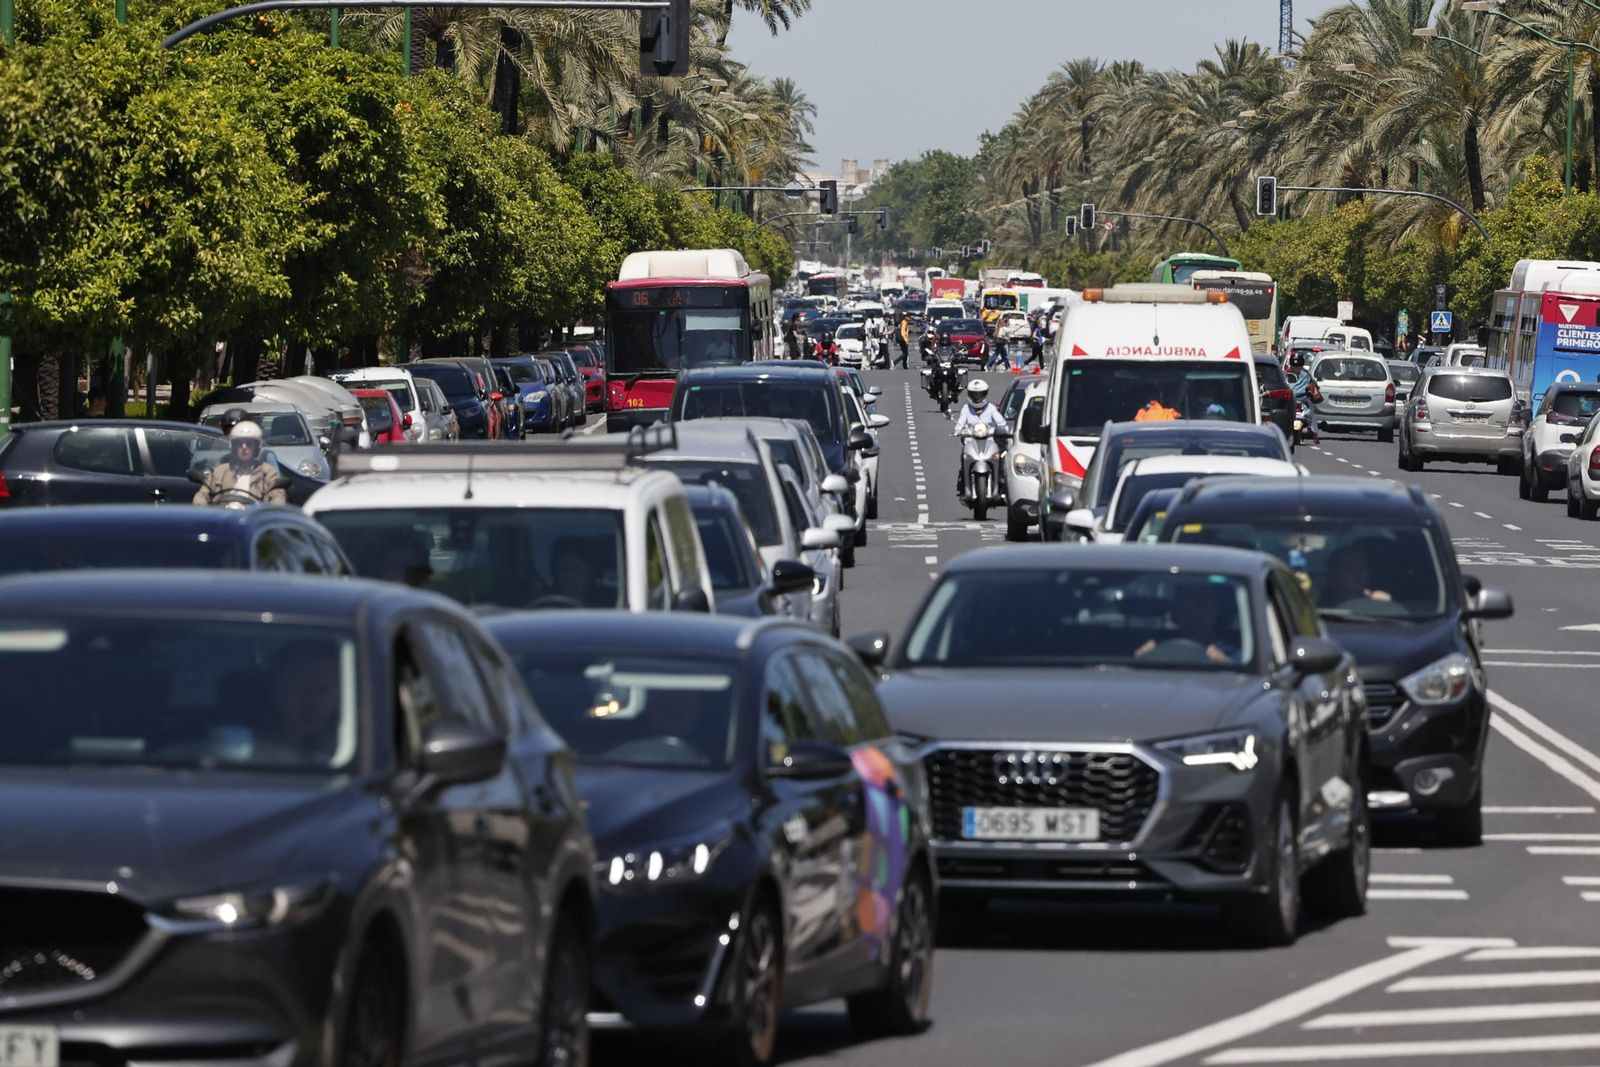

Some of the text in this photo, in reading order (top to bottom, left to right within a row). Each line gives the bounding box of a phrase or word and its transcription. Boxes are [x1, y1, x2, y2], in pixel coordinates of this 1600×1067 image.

[1557, 329, 1600, 340] CLIENTES
[626, 398, 644, 407] 102
[979, 811, 1034, 834] 0695
